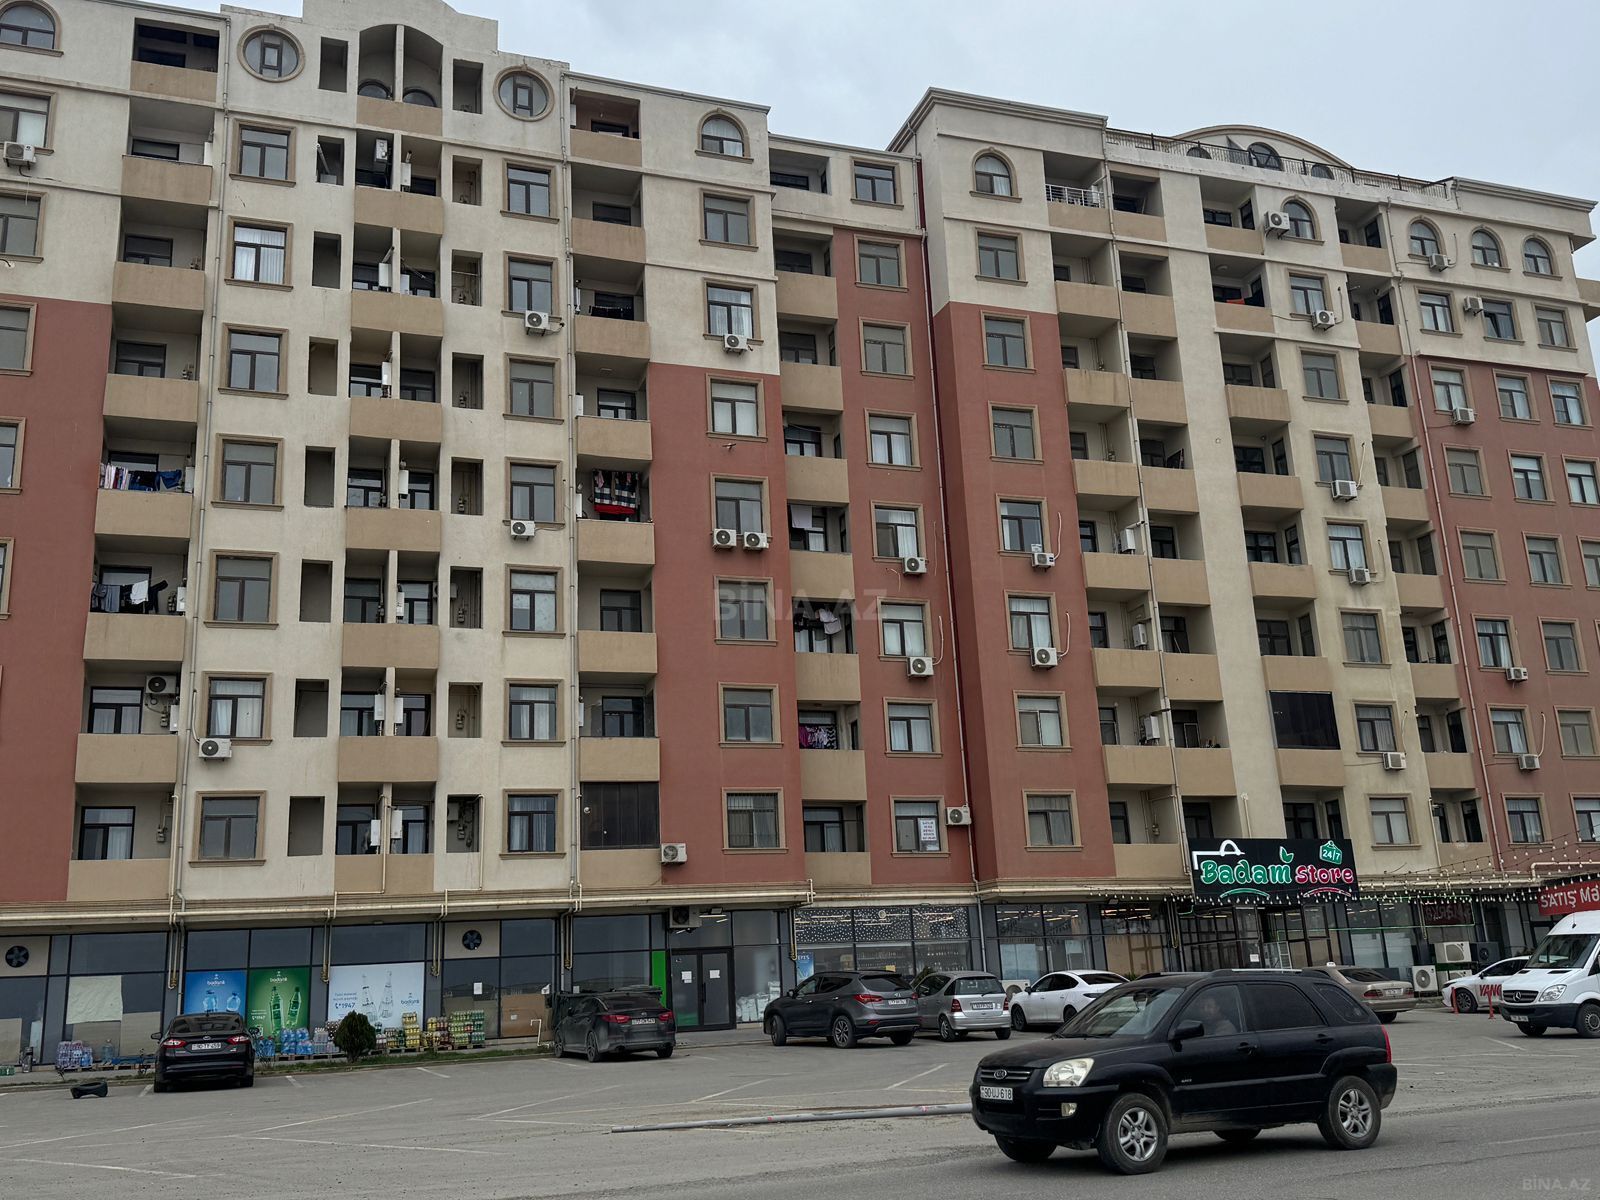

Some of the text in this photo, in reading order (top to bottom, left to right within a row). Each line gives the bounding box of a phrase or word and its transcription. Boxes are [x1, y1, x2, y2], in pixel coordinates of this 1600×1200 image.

[1322, 850, 1341, 861] 24/7
[1200, 859, 1292, 884] Badam
[1540, 891, 1577, 908] SATIŞ
